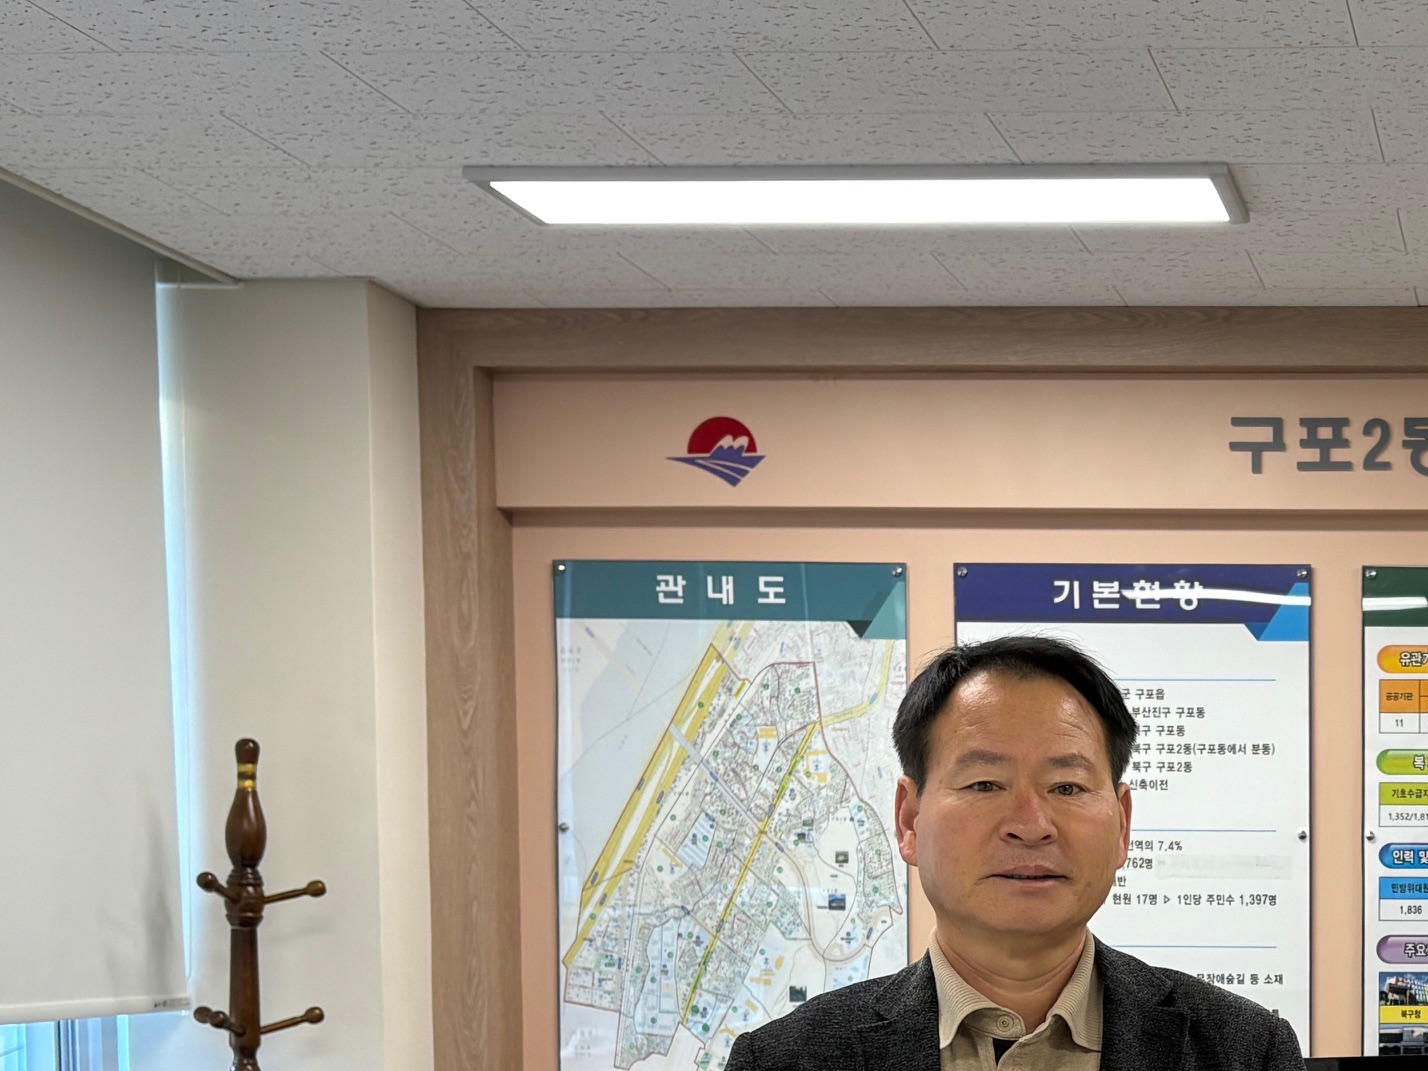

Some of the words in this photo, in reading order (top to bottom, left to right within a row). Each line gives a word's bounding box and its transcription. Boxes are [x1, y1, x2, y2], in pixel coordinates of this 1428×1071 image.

[1135, 688, 1165, 700] 구포읍
[1132, 706, 1171, 718] 부산진구
[1176, 706, 1206, 718] 구포동
[1395, 719, 1404, 727] 11
[1156, 725, 1185, 736] 구포동
[1132, 761, 1151, 773] 북구
[1156, 761, 1192, 773] 구포2동
[1129, 779, 1168, 791] 신축이전
[1392, 850, 1414, 865] 인력
[1418, 850, 1428, 865] 및
[1113, 893, 1131, 905] 현원
[1137, 893, 1157, 905] 17명
[1177, 893, 1201, 905] 1인당
[1206, 893, 1235, 905] 주민수
[1239, 893, 1277, 905] 1,397명
[1400, 906, 1422, 915] 1,836
[1250, 973, 1259, 985] 등
[1264, 973, 1284, 985] 소재
